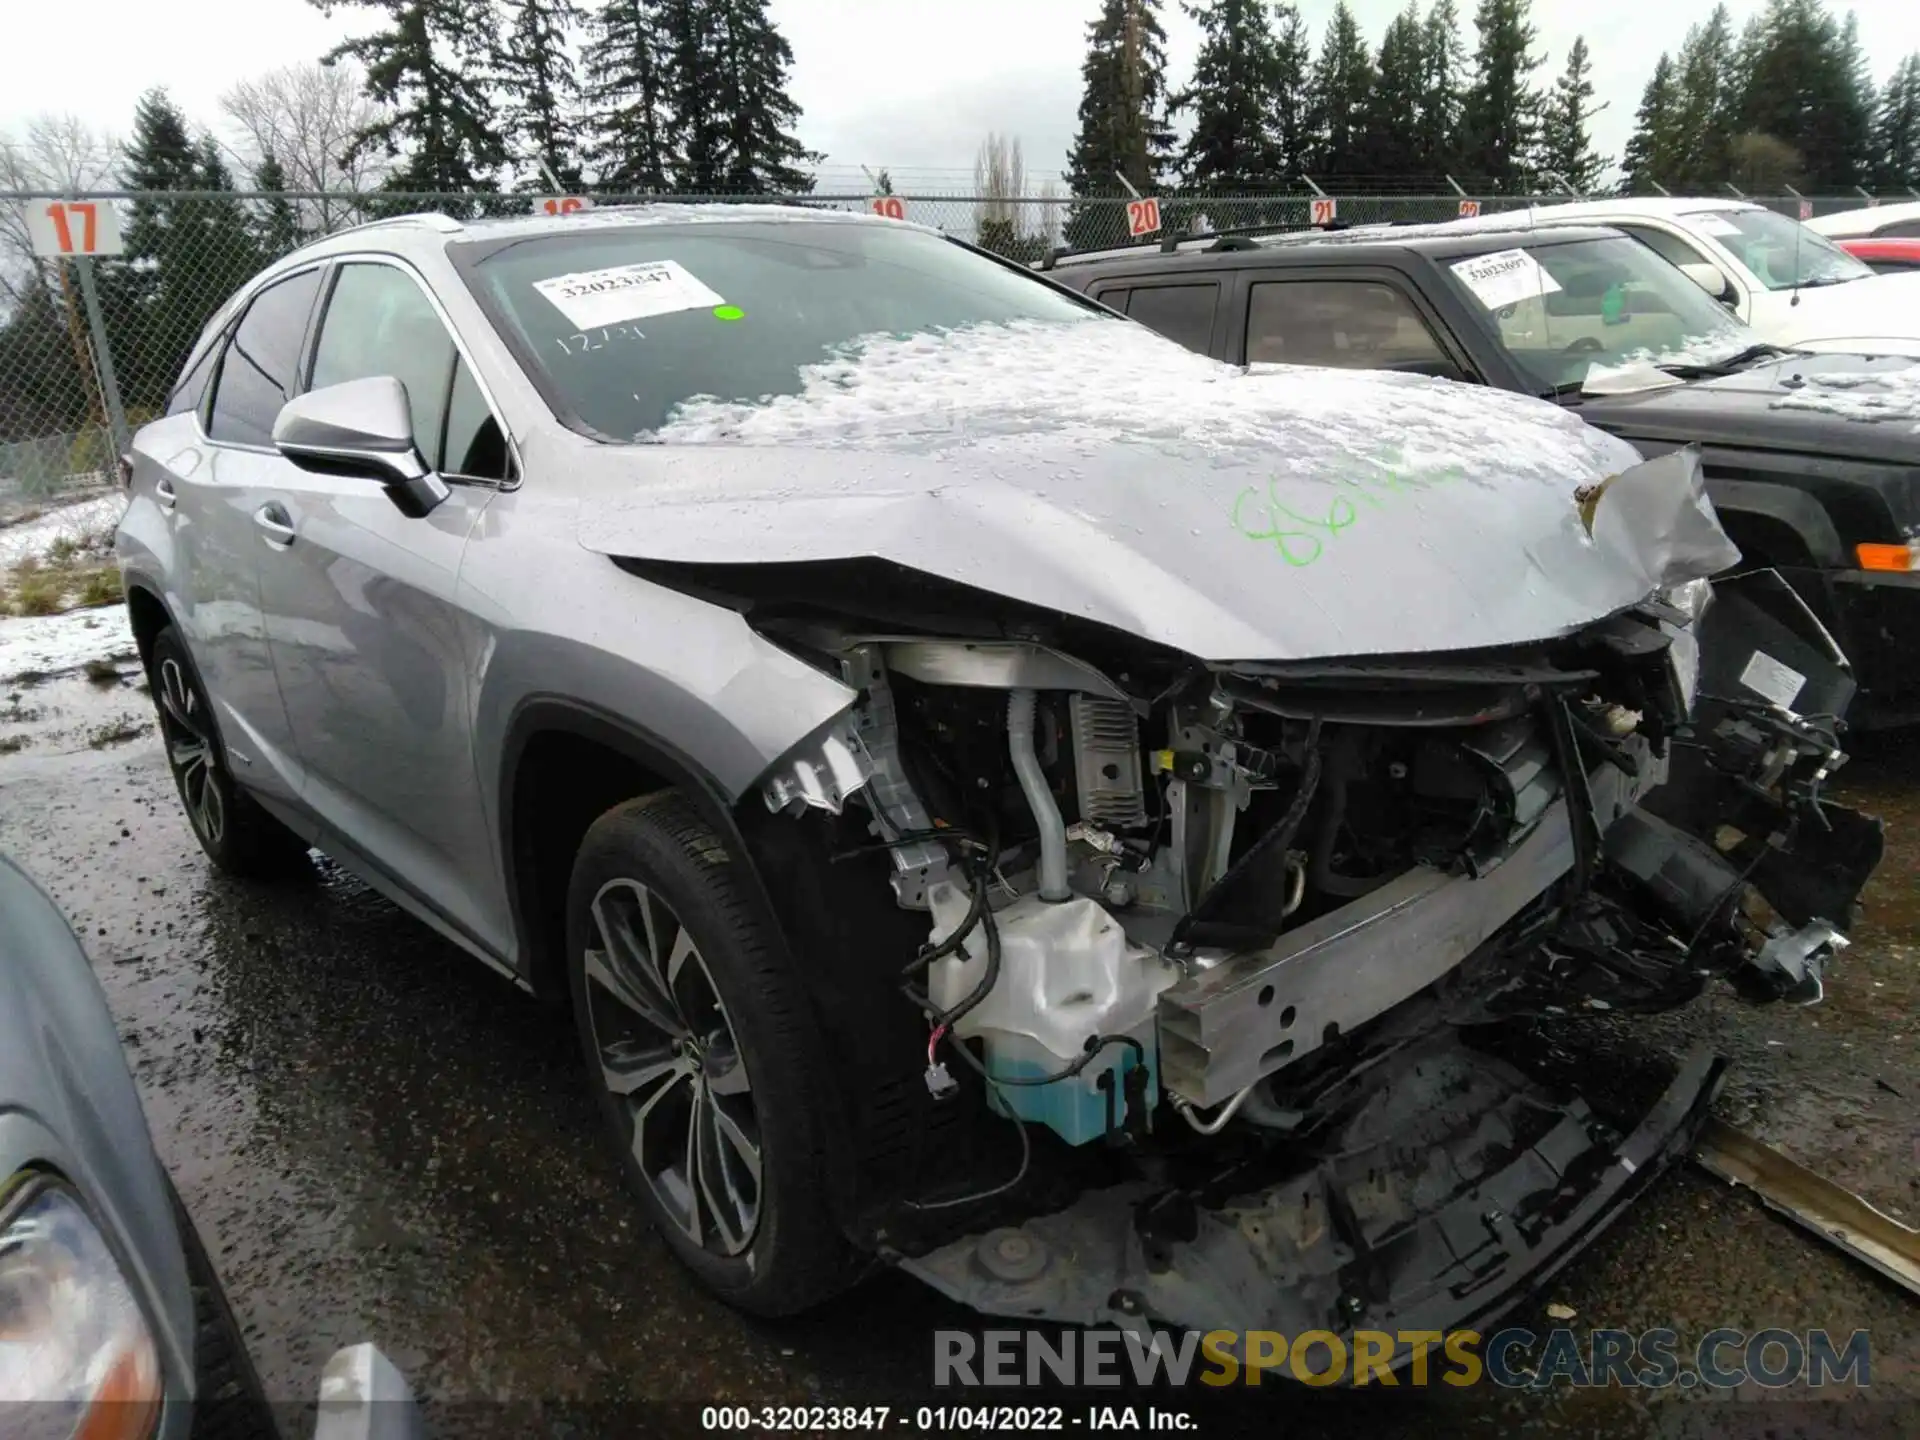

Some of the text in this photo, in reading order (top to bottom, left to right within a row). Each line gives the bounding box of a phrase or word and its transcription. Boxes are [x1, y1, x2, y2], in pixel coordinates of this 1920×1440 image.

[46, 203, 97, 252] 17
[1130, 200, 1158, 233] 20
[1315, 200, 1333, 224] 21
